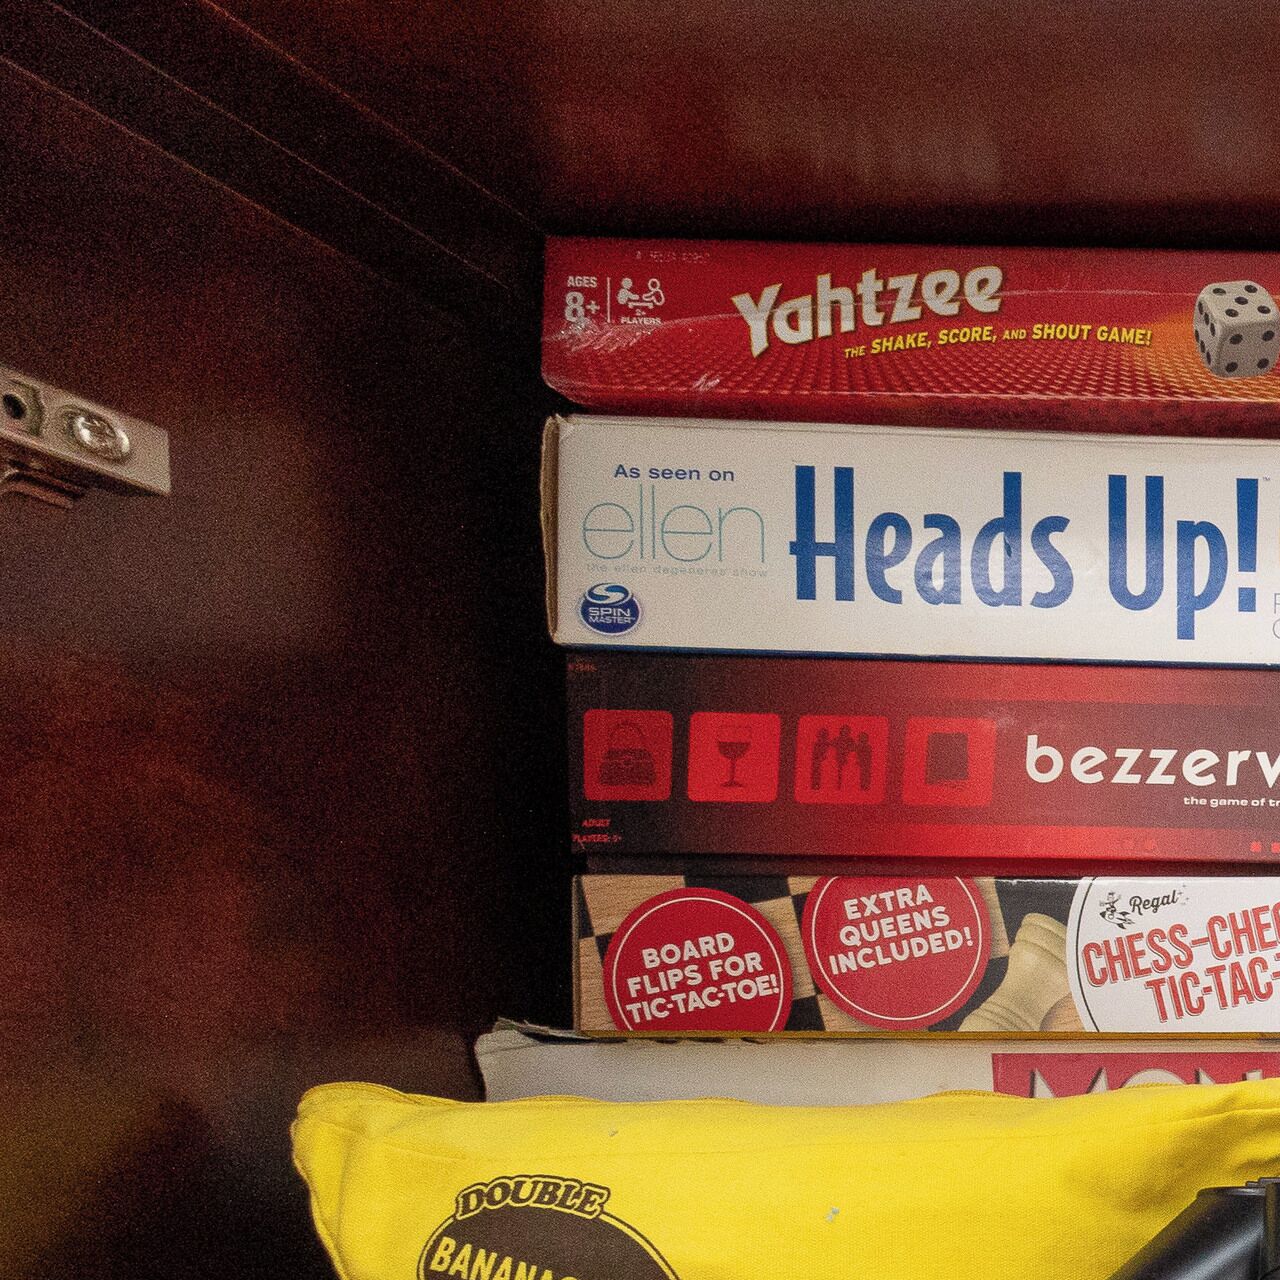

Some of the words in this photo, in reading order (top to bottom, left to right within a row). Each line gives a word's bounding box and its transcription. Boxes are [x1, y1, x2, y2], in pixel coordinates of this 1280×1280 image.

[731, 265, 1003, 359] Yahtzee
[844, 345, 866, 359] THE
[870, 331, 932, 354] SHAKE,
[938, 325, 997, 347] SCORE,
[1003, 329, 1027, 340] AND
[1032, 324, 1091, 342] SHOUT
[1096, 326, 1153, 346] GAME!
[614, 464, 642, 480] As
[648, 468, 701, 481] seen
[708, 469, 735, 482] on
[581, 485, 766, 564] ellen
[789, 465, 1075, 609] Heads
[1107, 474, 1259, 641] Up!
[1184, 796, 1202, 806] the
[1205, 797, 1248, 810] game
[1251, 797, 1266, 808] of
[844, 884, 933, 920] EXTRA
[838, 906, 950, 948] QUEENS
[641, 932, 735, 968] BOARD
[829, 927, 973, 975] INCLUDED!
[627, 965, 701, 998] FLIPS
[709, 953, 763, 979] FOR
[626, 974, 780, 1024] TIC-TAC-TOE!
[459, 1177, 609, 1220] DOUBLE
